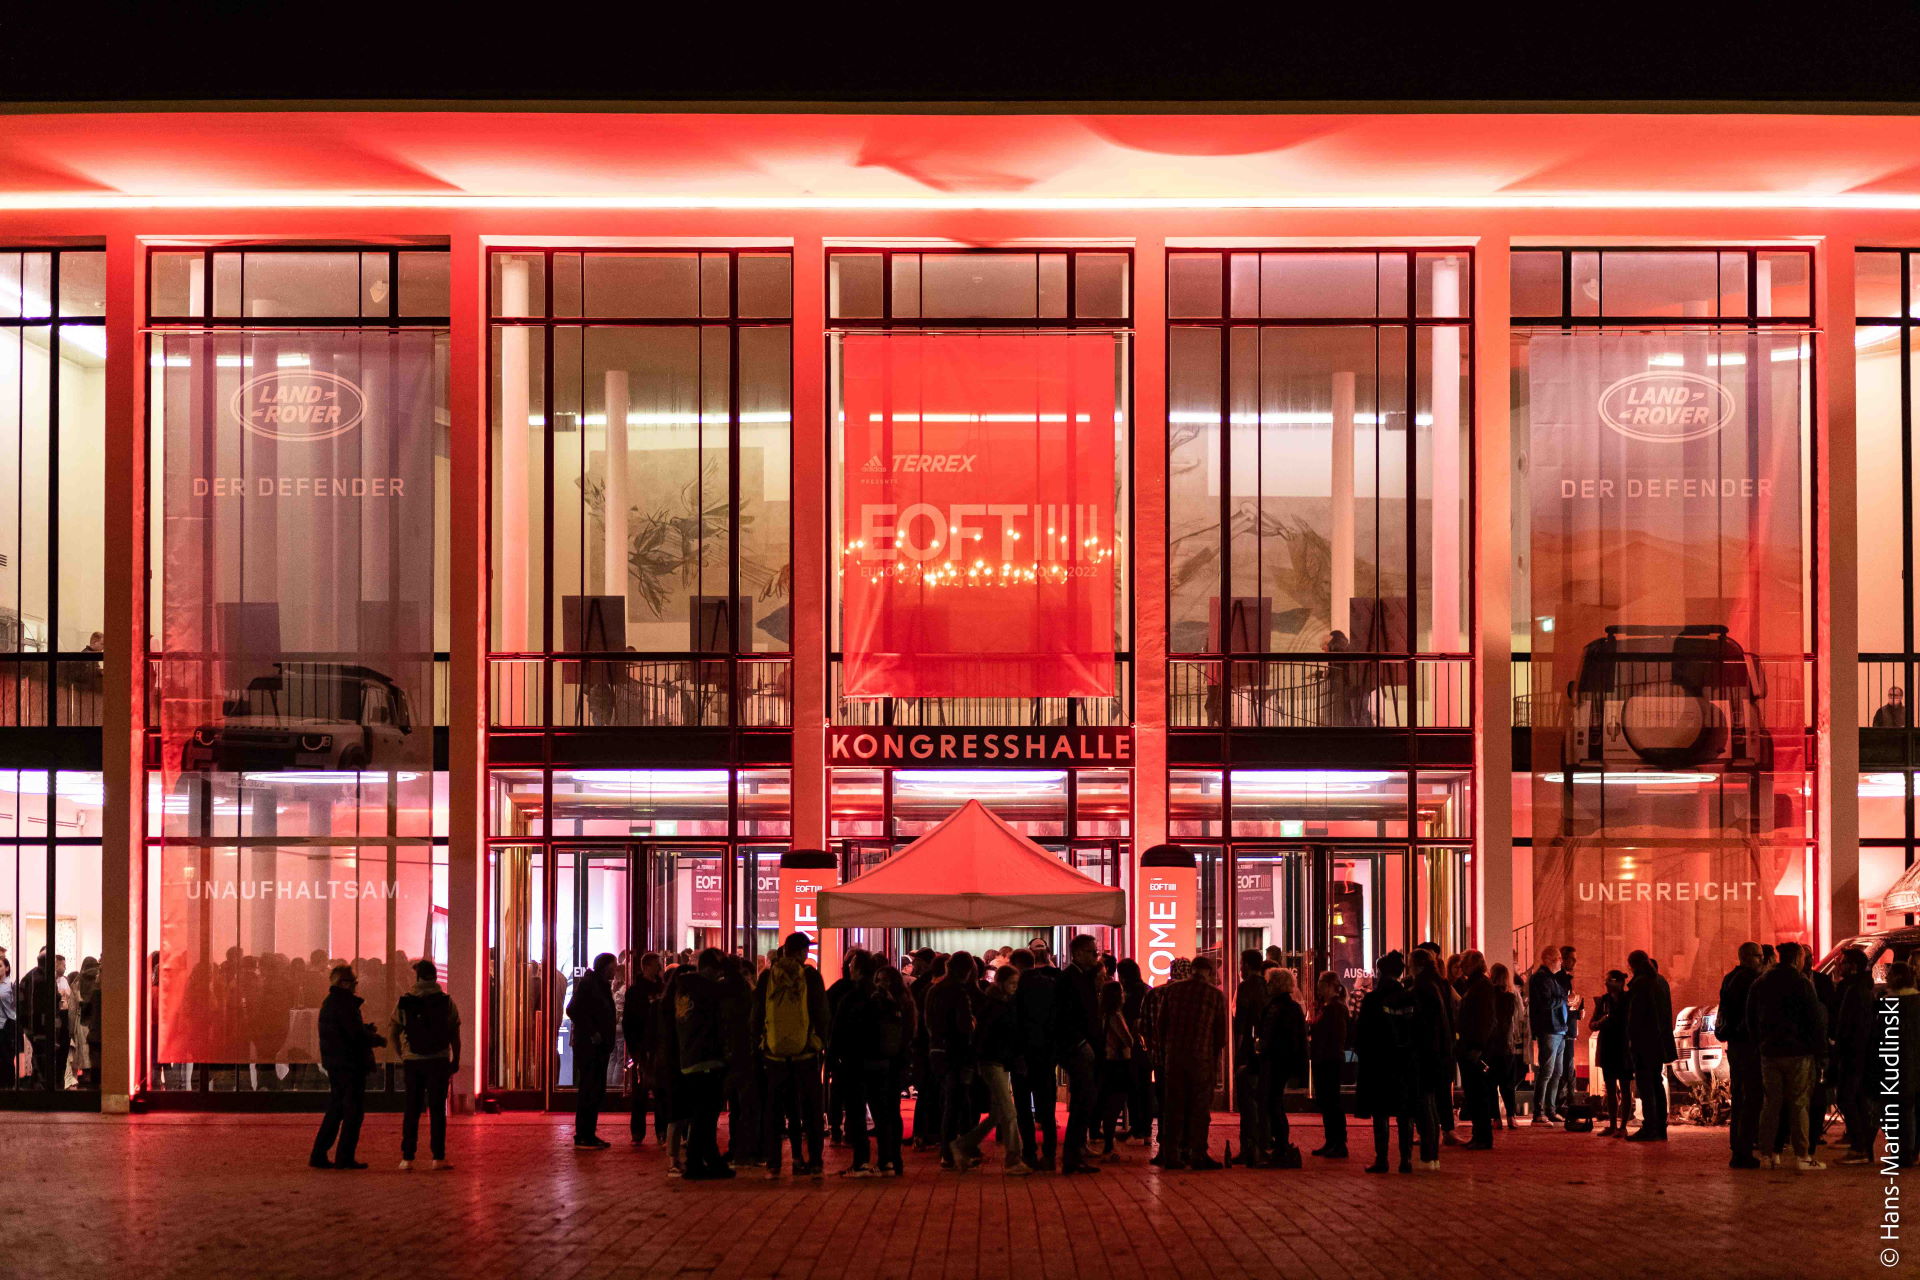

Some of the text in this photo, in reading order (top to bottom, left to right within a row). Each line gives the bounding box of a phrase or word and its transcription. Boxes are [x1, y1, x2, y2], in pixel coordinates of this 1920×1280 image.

[259, 386, 322, 404] LAND
[1627, 387, 1690, 405] LAND
[264, 405, 341, 424] ROVER
[1632, 406, 1709, 425] ROVER
[892, 454, 976, 473] TERREX
[193, 477, 405, 497] DER DEFENDER
[1561, 478, 1773, 498] DER DEFENDER
[1067, 565, 1098, 577] 2022
[831, 734, 1130, 759] KONGRESSHALLE
[186, 880, 408, 900] UNAUFHALTSAM.
[1579, 882, 1762, 902] UNERREICHT.
